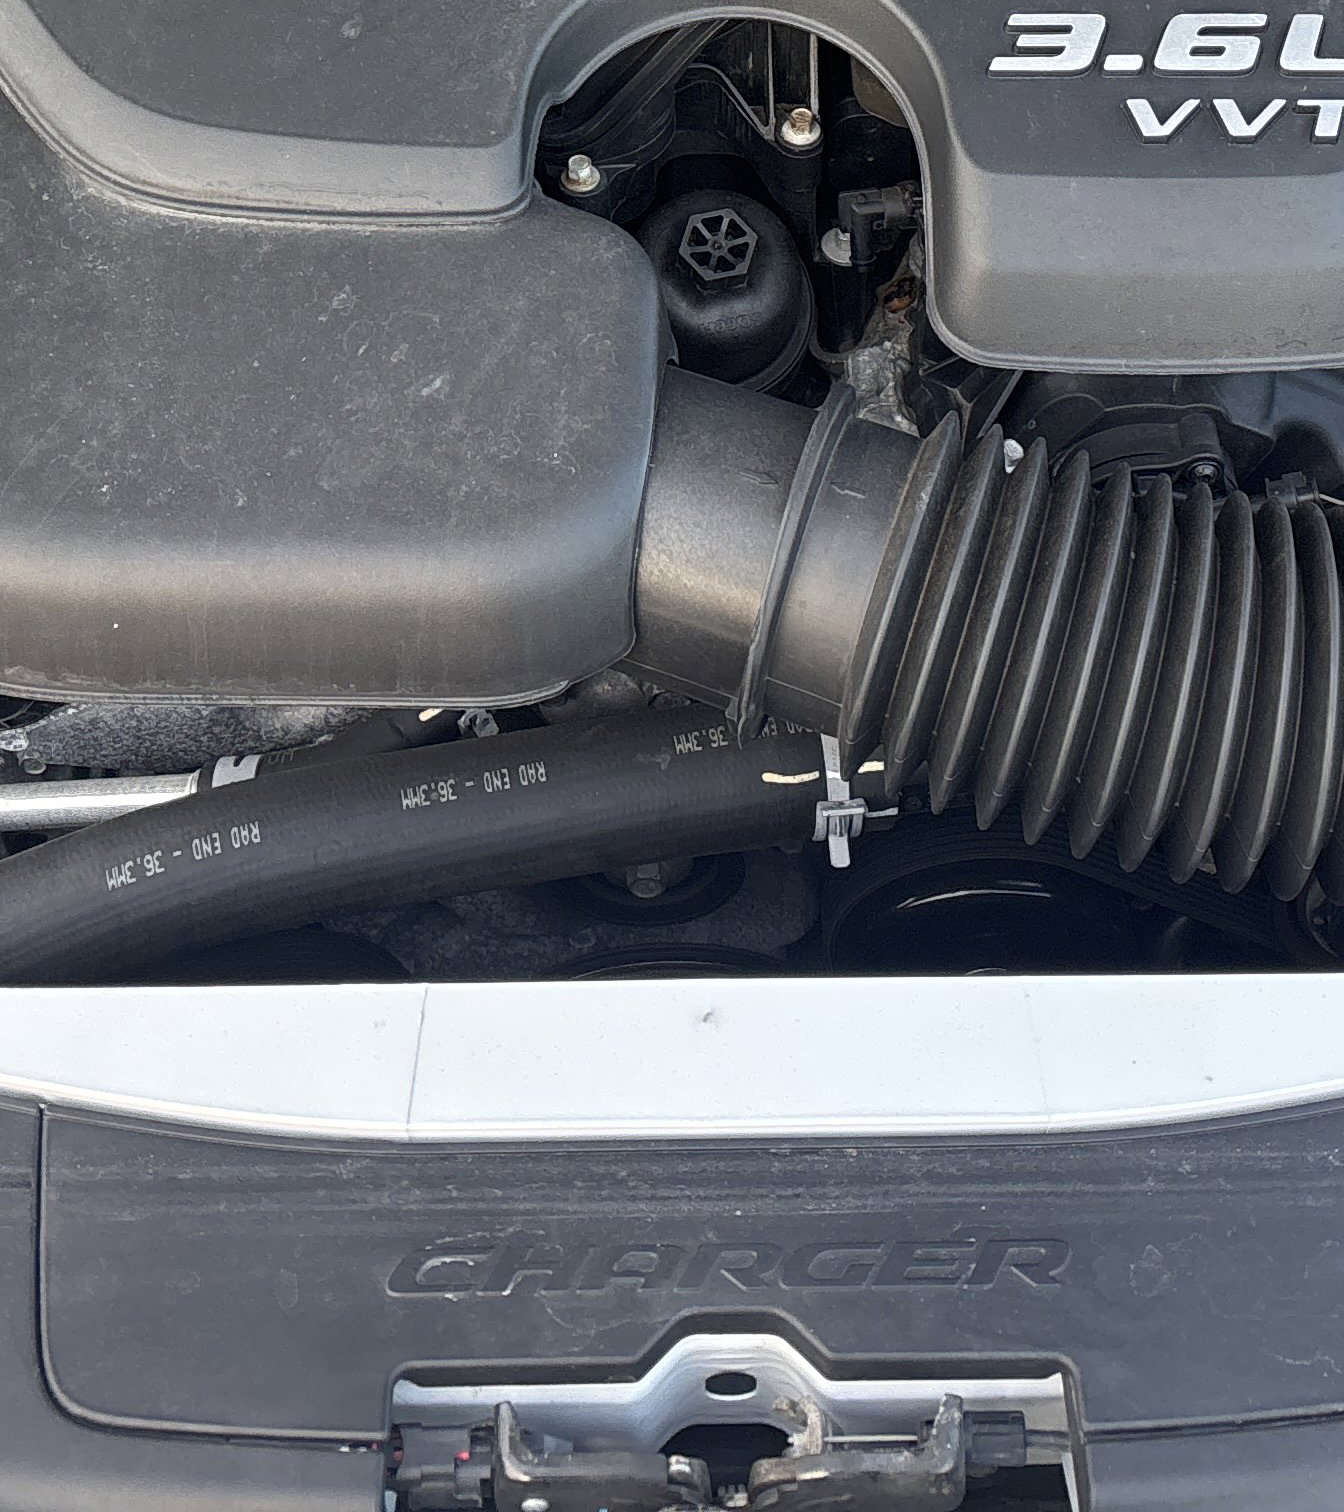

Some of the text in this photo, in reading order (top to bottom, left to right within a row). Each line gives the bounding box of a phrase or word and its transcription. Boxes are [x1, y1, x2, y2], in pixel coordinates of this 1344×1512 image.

[672, 725, 729, 755] 36.3MM
[483, 768, 511, 793] END
[518, 760, 547, 786] RAD
[400, 778, 458, 810] 36.3MM
[191, 832, 222, 860] END
[230, 821, 261, 849] RAD
[105, 850, 165, 891] 36.3MM
[385, 1239, 1072, 1297] CHARGER
